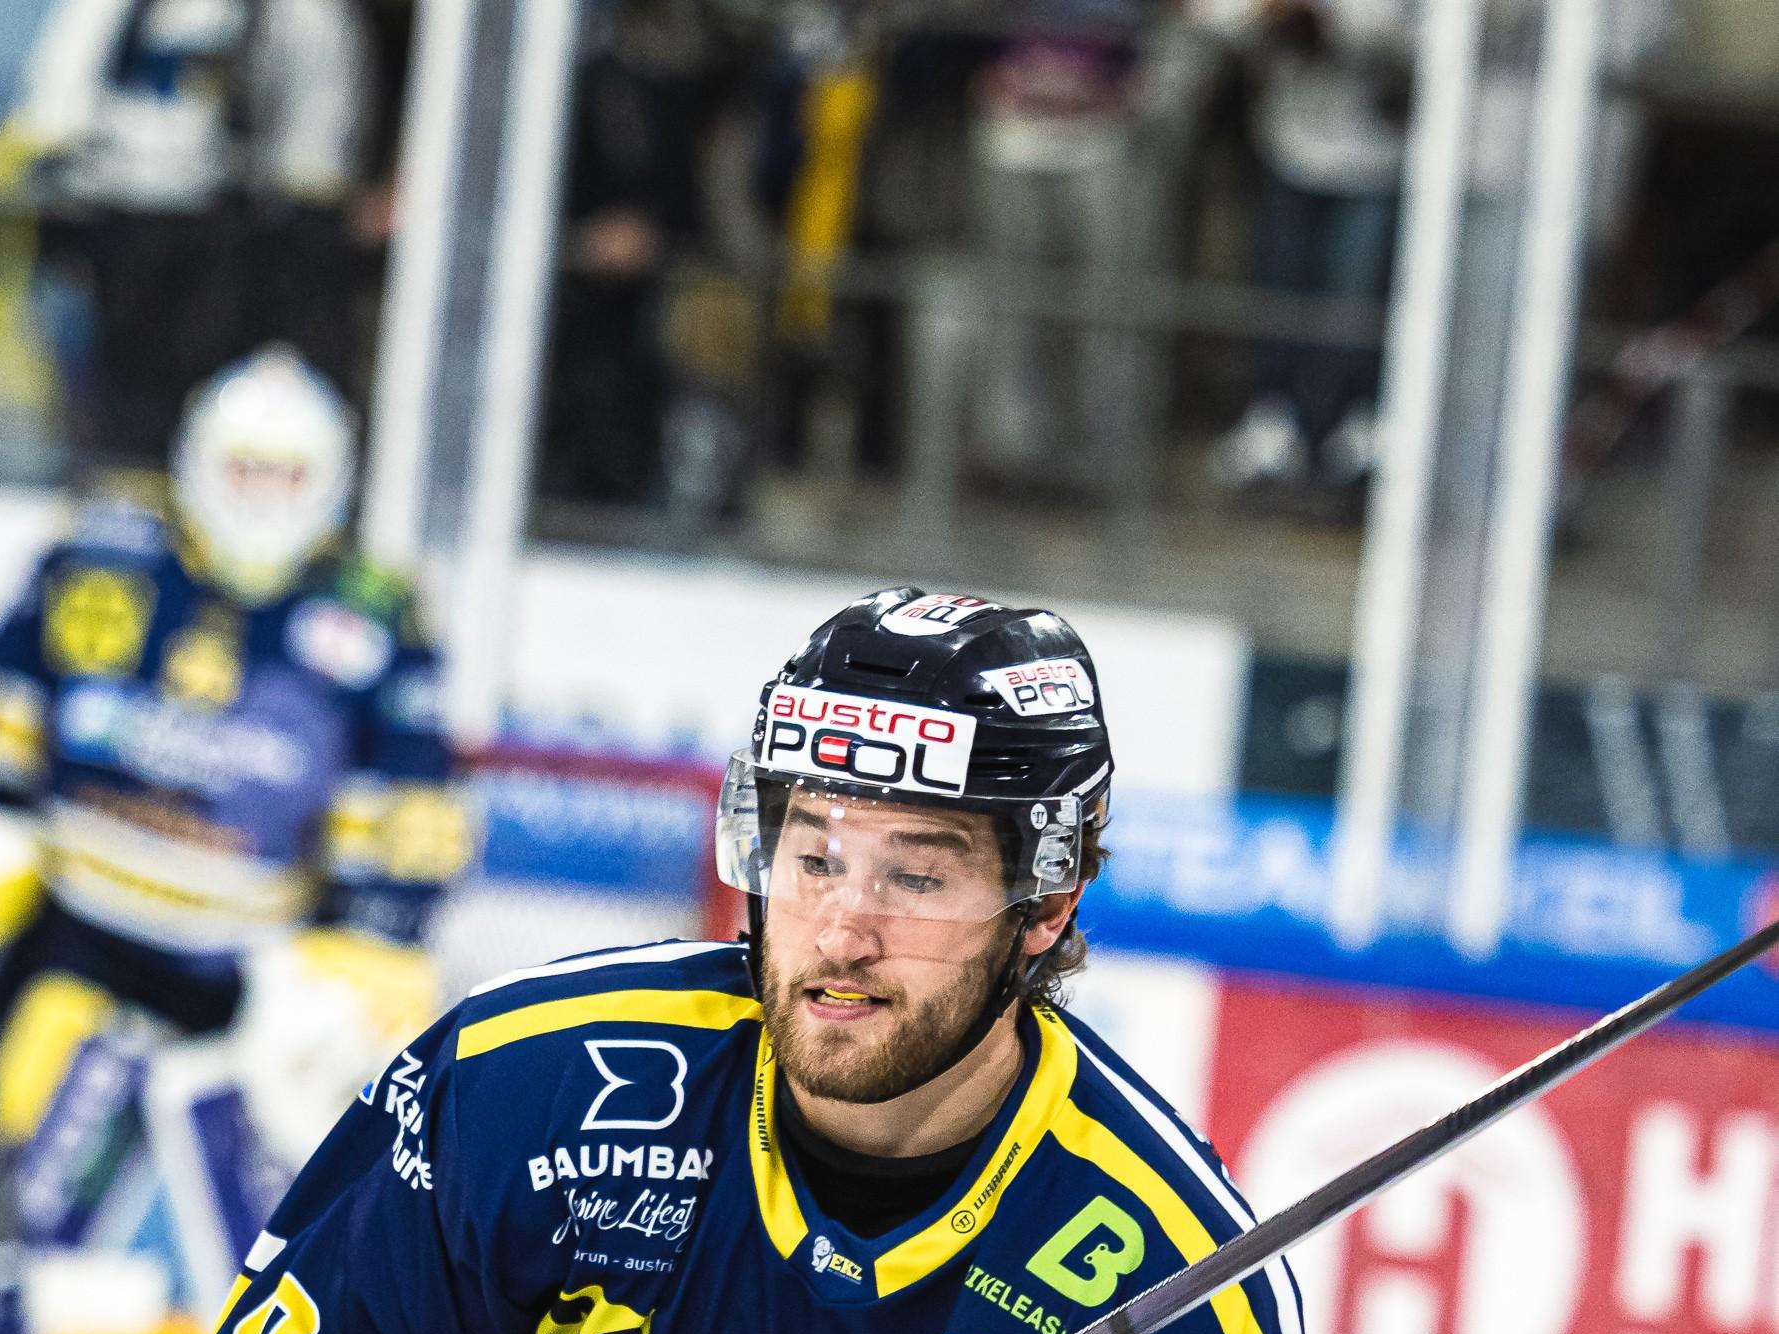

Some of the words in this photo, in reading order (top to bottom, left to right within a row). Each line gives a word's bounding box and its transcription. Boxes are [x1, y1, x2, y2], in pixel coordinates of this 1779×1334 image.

[1006, 664, 1077, 686] austro
[773, 693, 956, 744] austro
[768, 720, 962, 793] POOL
[973, 1141, 1022, 1211] WARRIOR
